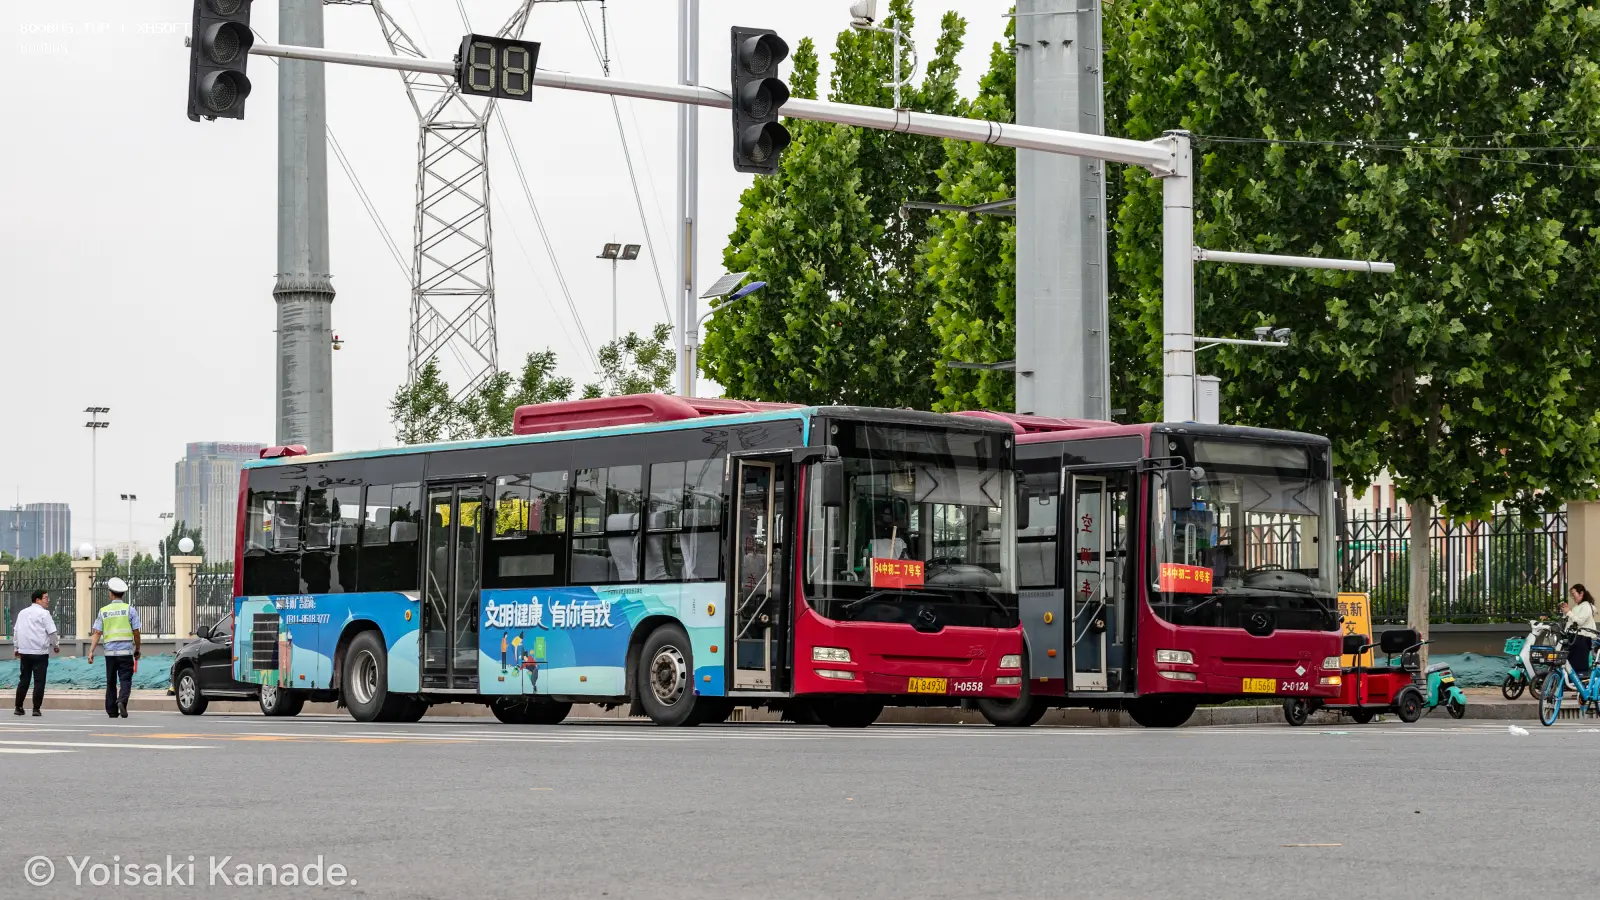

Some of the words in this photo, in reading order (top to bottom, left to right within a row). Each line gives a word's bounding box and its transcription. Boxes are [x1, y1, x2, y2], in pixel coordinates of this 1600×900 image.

[904, 564, 921, 577] 7号车
[1194, 570, 1210, 583] 8号车
[485, 596, 549, 629] 文明健康
[548, 596, 614, 628] 有你有我
[1337, 601, 1362, 616] 高新
[953, 681, 983, 692] 1-0558
[1281, 681, 1309, 692] 2-0124
